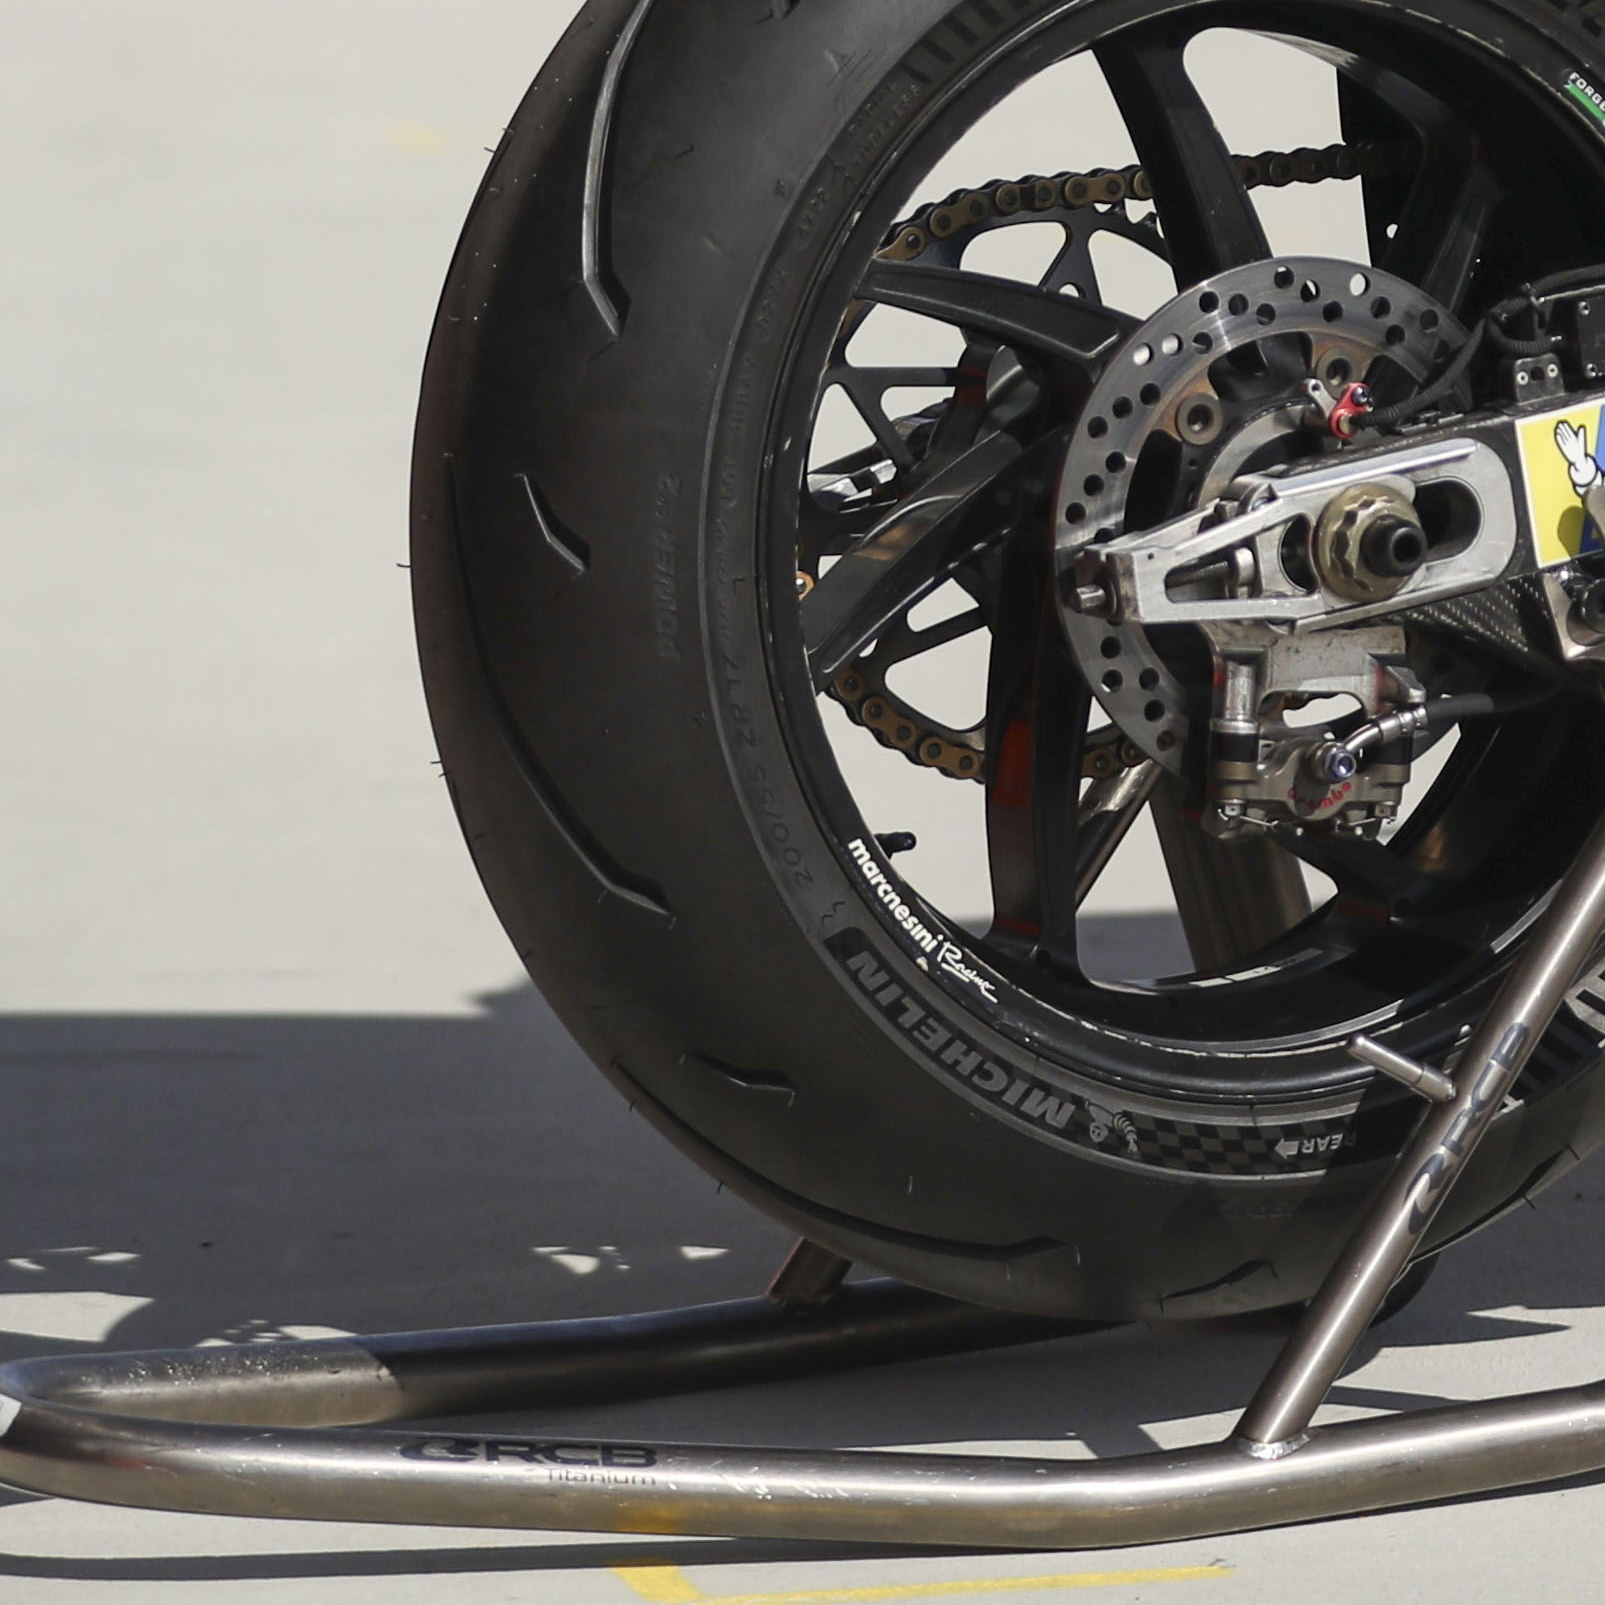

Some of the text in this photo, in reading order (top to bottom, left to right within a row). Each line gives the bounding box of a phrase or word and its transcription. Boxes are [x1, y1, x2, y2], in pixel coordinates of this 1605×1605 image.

[845, 950, 1076, 1129] MICHELIN
[486, 1442, 659, 1469] RCB
[547, 1467, 658, 1486] Titanium
